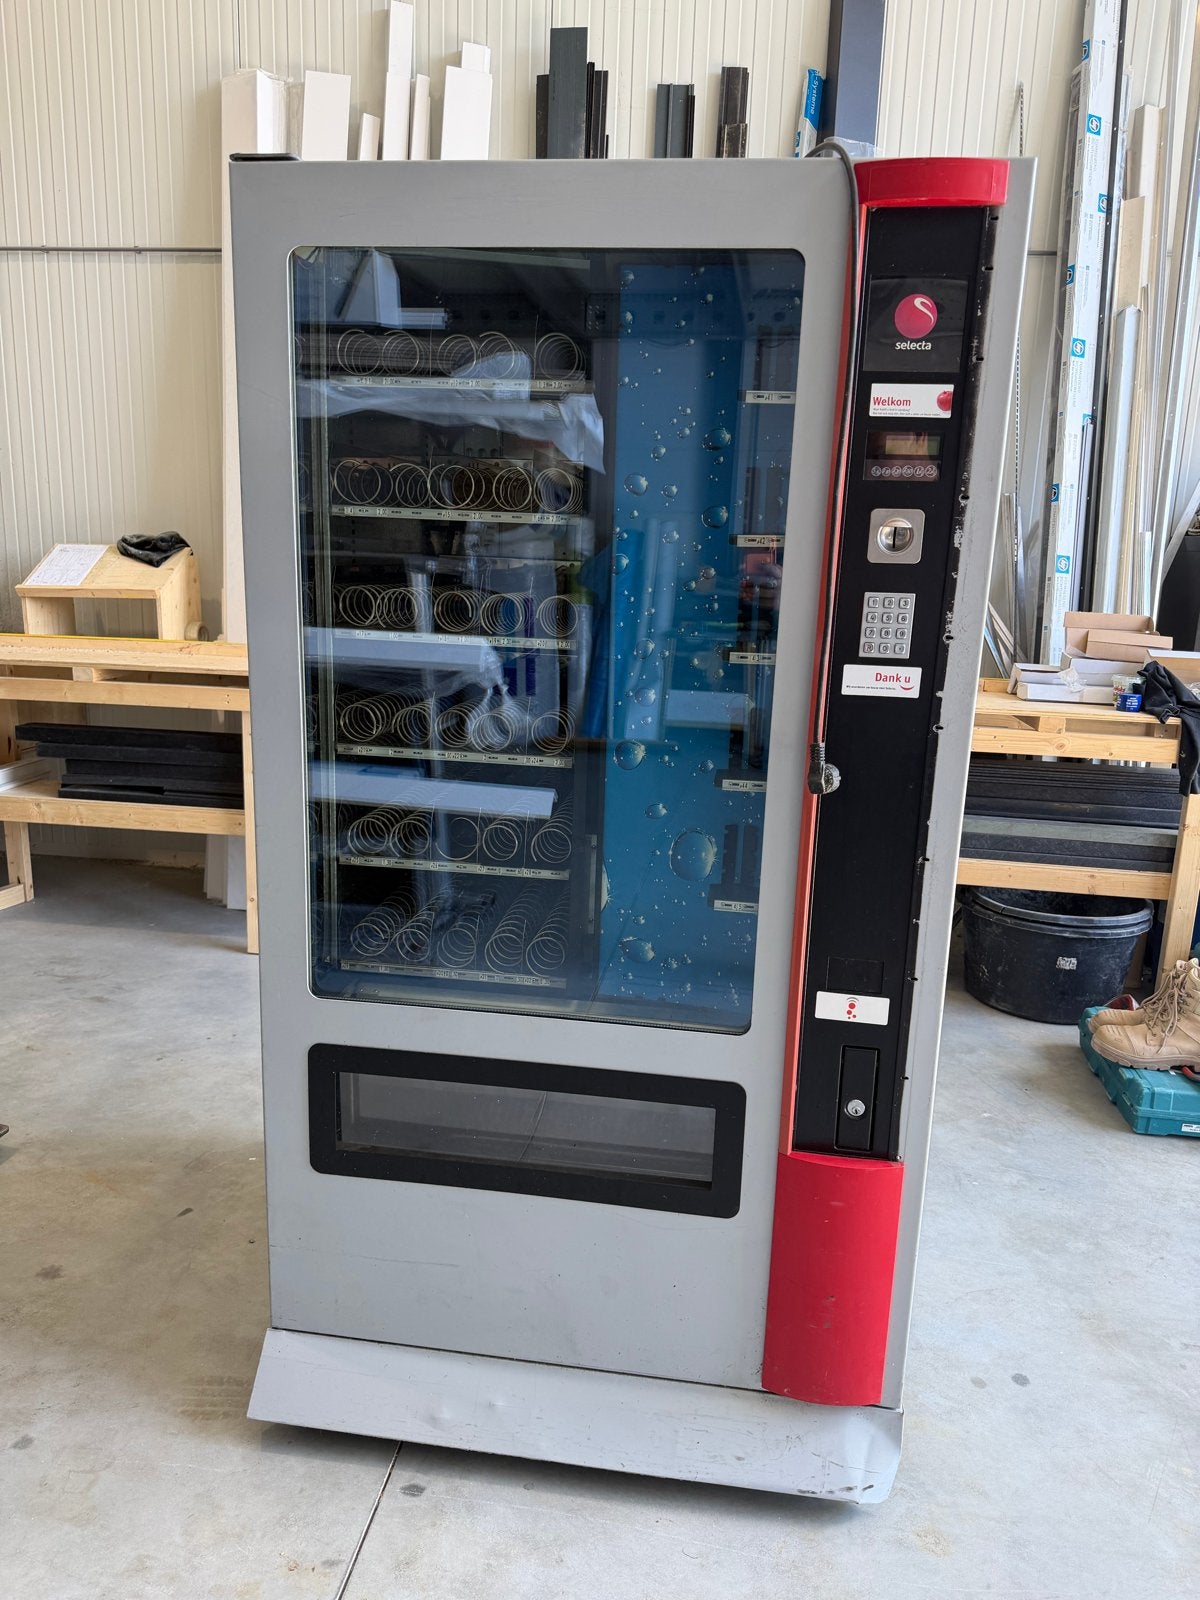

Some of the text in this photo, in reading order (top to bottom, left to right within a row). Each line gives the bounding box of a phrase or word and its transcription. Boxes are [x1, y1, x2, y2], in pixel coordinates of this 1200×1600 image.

[895, 340, 932, 350] selecta
[872, 396, 911, 407] Welkom
[875, 672, 911, 683] Dank u
